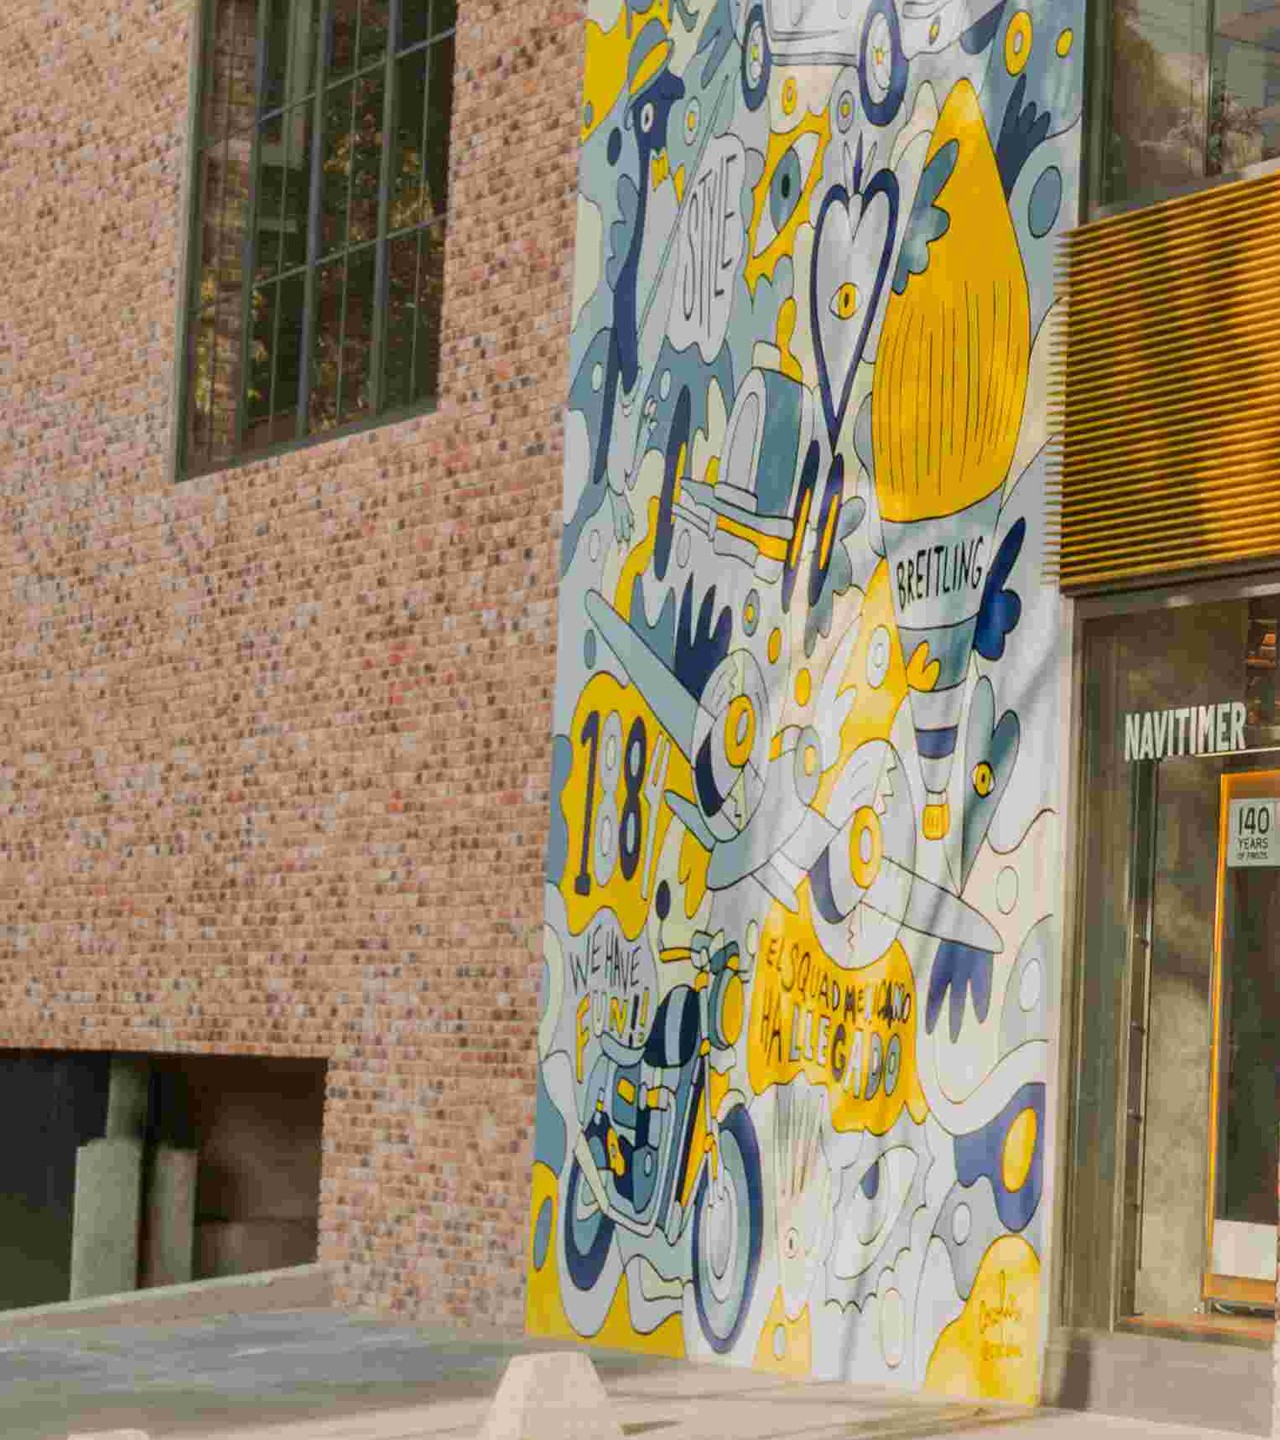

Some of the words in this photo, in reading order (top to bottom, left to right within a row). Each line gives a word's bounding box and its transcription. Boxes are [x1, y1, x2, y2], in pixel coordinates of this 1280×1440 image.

[683, 152, 738, 340] STYLE
[897, 535, 984, 612] BREITLING
[1125, 701, 1248, 762] NAVITIMER
[578, 709, 672, 902] 1884
[1238, 806, 1270, 836] 140
[1237, 836, 1269, 852] YEARS
[570, 924, 602, 995] WE
[604, 929, 641, 992] HAVE
